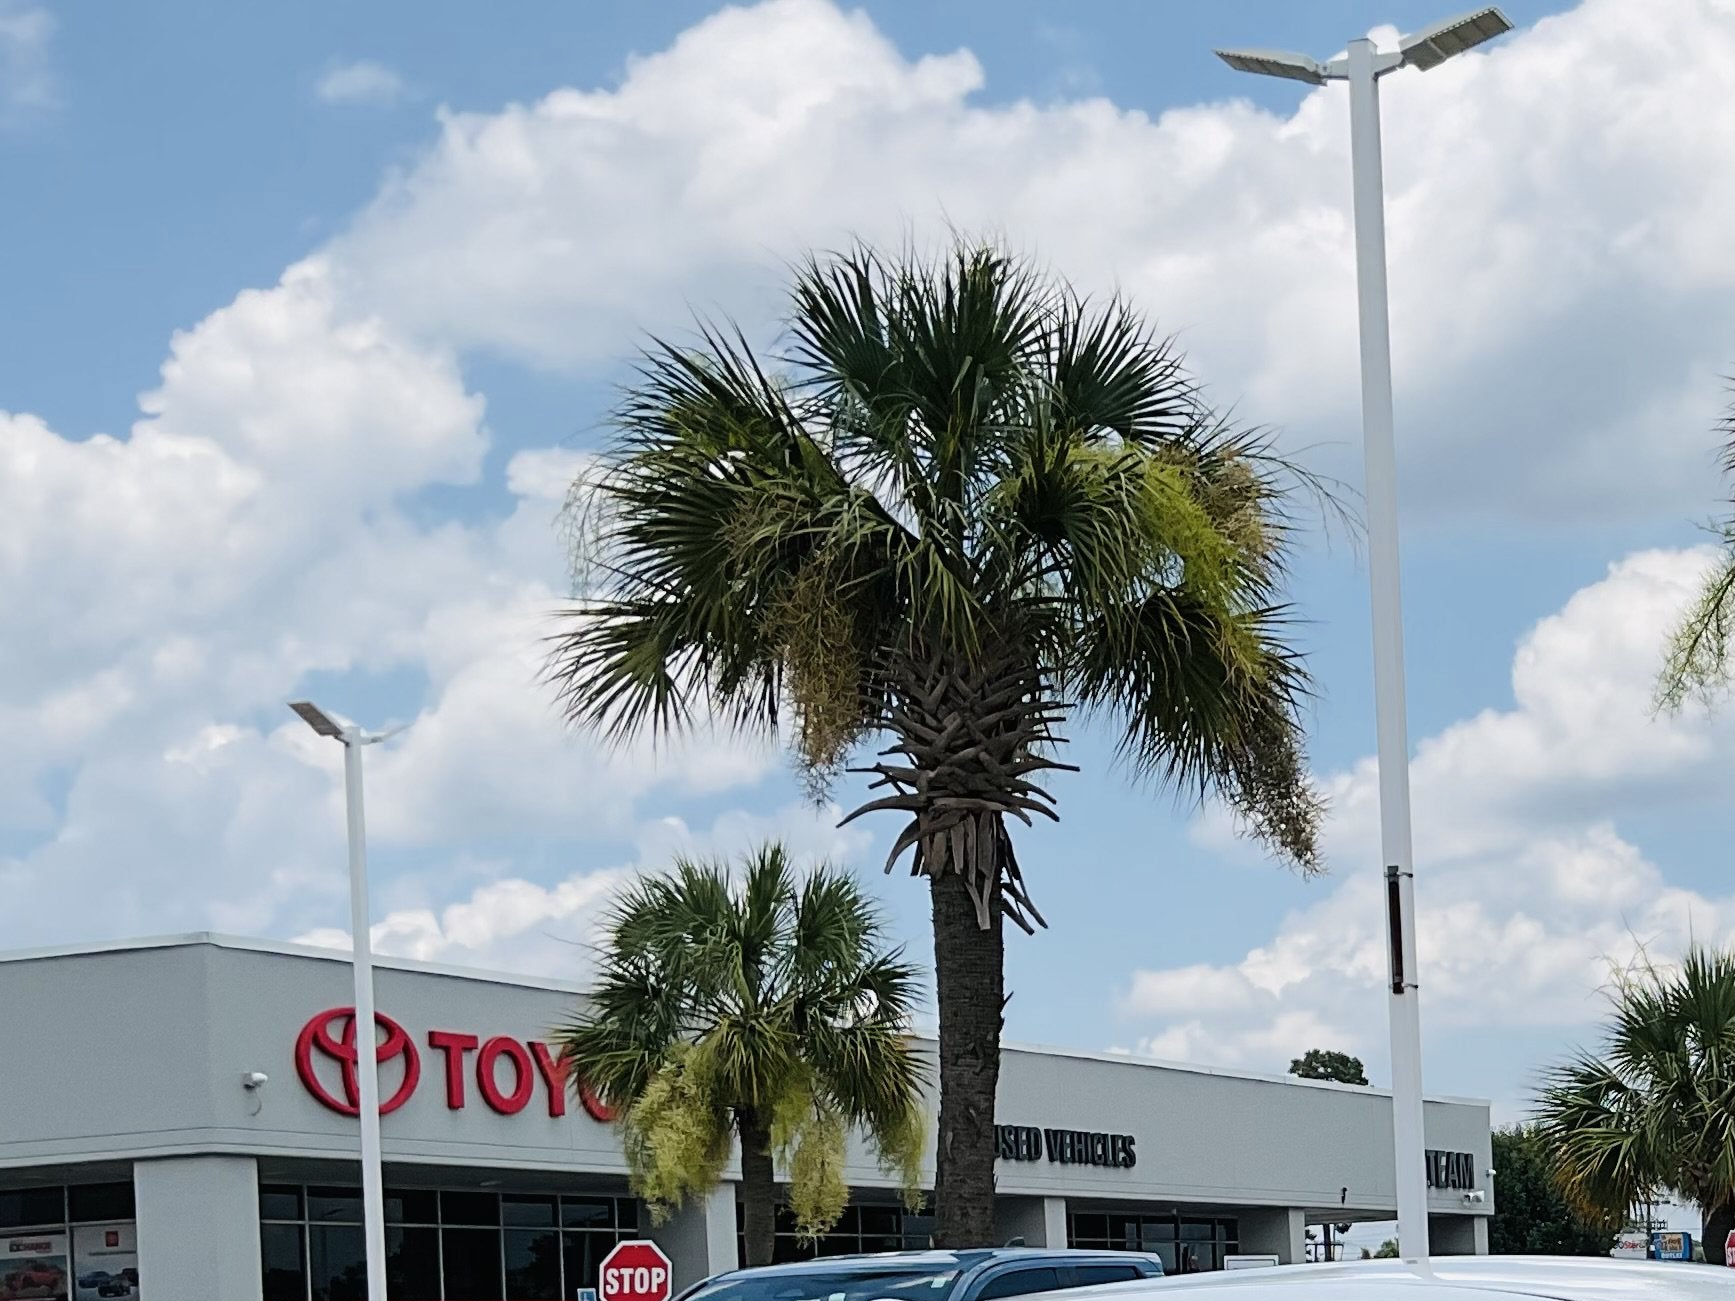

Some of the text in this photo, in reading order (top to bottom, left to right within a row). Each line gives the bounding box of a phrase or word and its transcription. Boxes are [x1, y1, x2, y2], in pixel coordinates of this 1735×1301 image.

[1043, 1128, 1137, 1169] VEHICLES
[1425, 1149, 1475, 1190] TEAM
[605, 1267, 666, 1295] STOP
